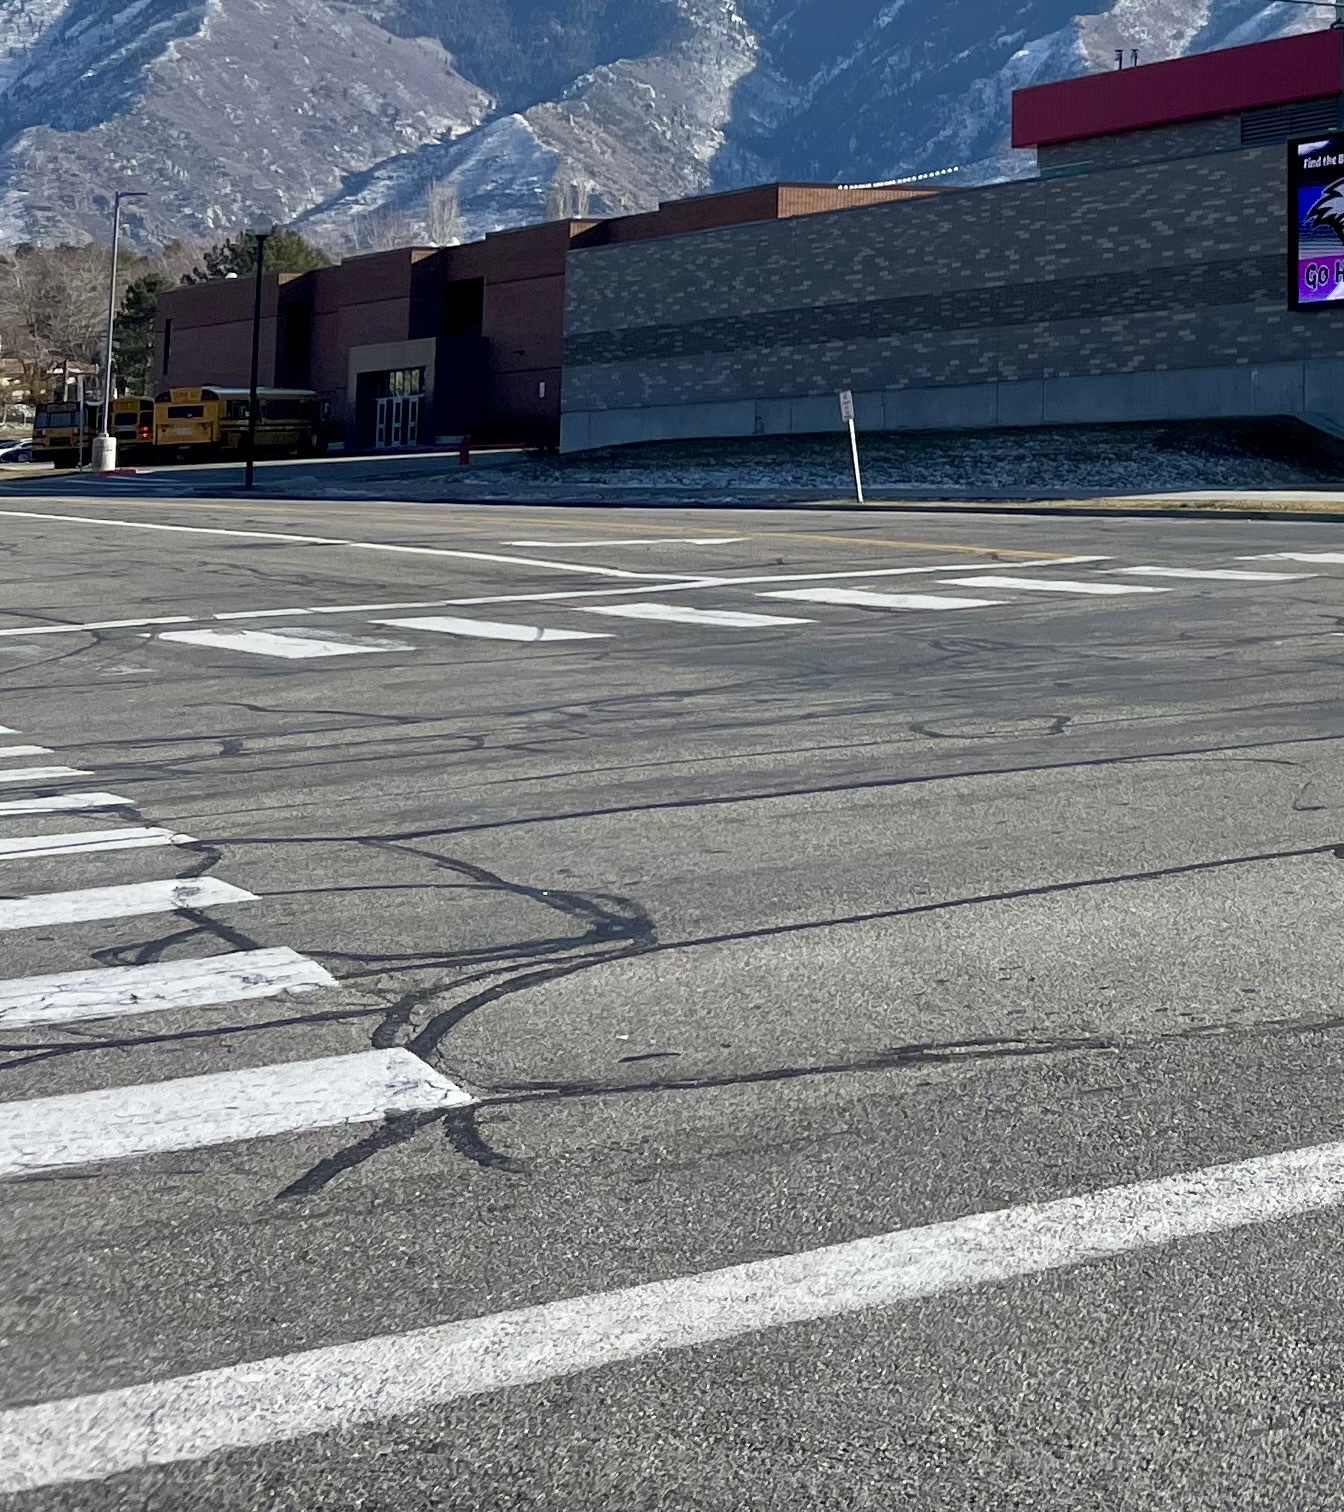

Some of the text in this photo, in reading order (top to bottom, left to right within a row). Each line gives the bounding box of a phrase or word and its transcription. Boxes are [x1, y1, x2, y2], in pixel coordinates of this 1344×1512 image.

[1303, 157, 1322, 169] Find
[1322, 155, 1337, 166] the
[1305, 263, 1329, 290] Go
